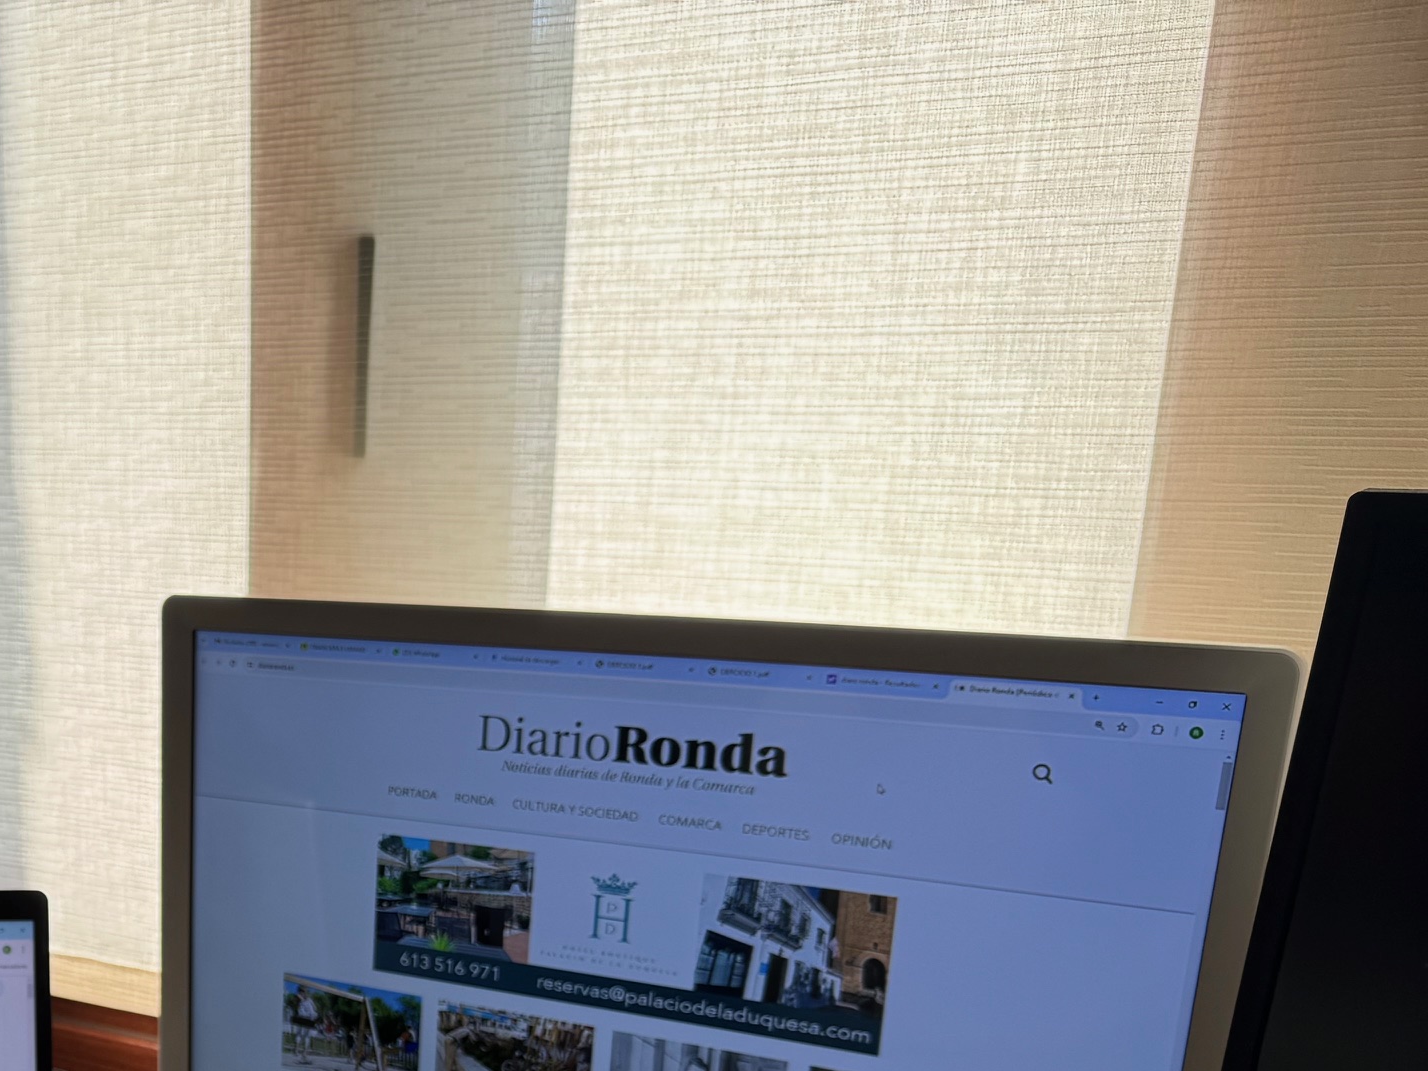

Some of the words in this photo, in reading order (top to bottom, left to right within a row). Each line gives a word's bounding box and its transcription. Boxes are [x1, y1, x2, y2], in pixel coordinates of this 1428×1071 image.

[502, 759, 552, 777] Noticias
[554, 762, 599, 780] diarias
[601, 767, 618, 782] de
[620, 770, 663, 787] Ronda
[664, 776, 674, 790] y
[675, 774, 690, 789] la
[692, 776, 755, 796] Comarca
[388, 785, 438, 800] PORTADA
[454, 793, 494, 806] RONDA
[512, 799, 565, 814] CULTURA
[568, 804, 576, 814] Y
[578, 806, 639, 822] SOCIEDAD
[658, 813, 722, 831] COMARCA
[742, 823, 809, 842] DEPORTES
[831, 832, 893, 851] OPINIÓN
[399, 951, 432, 970] 613
[434, 956, 465, 976] 516
[469, 963, 501, 982] 971
[536, 976, 871, 1045] reservas@palaciodeladuquesa.com
